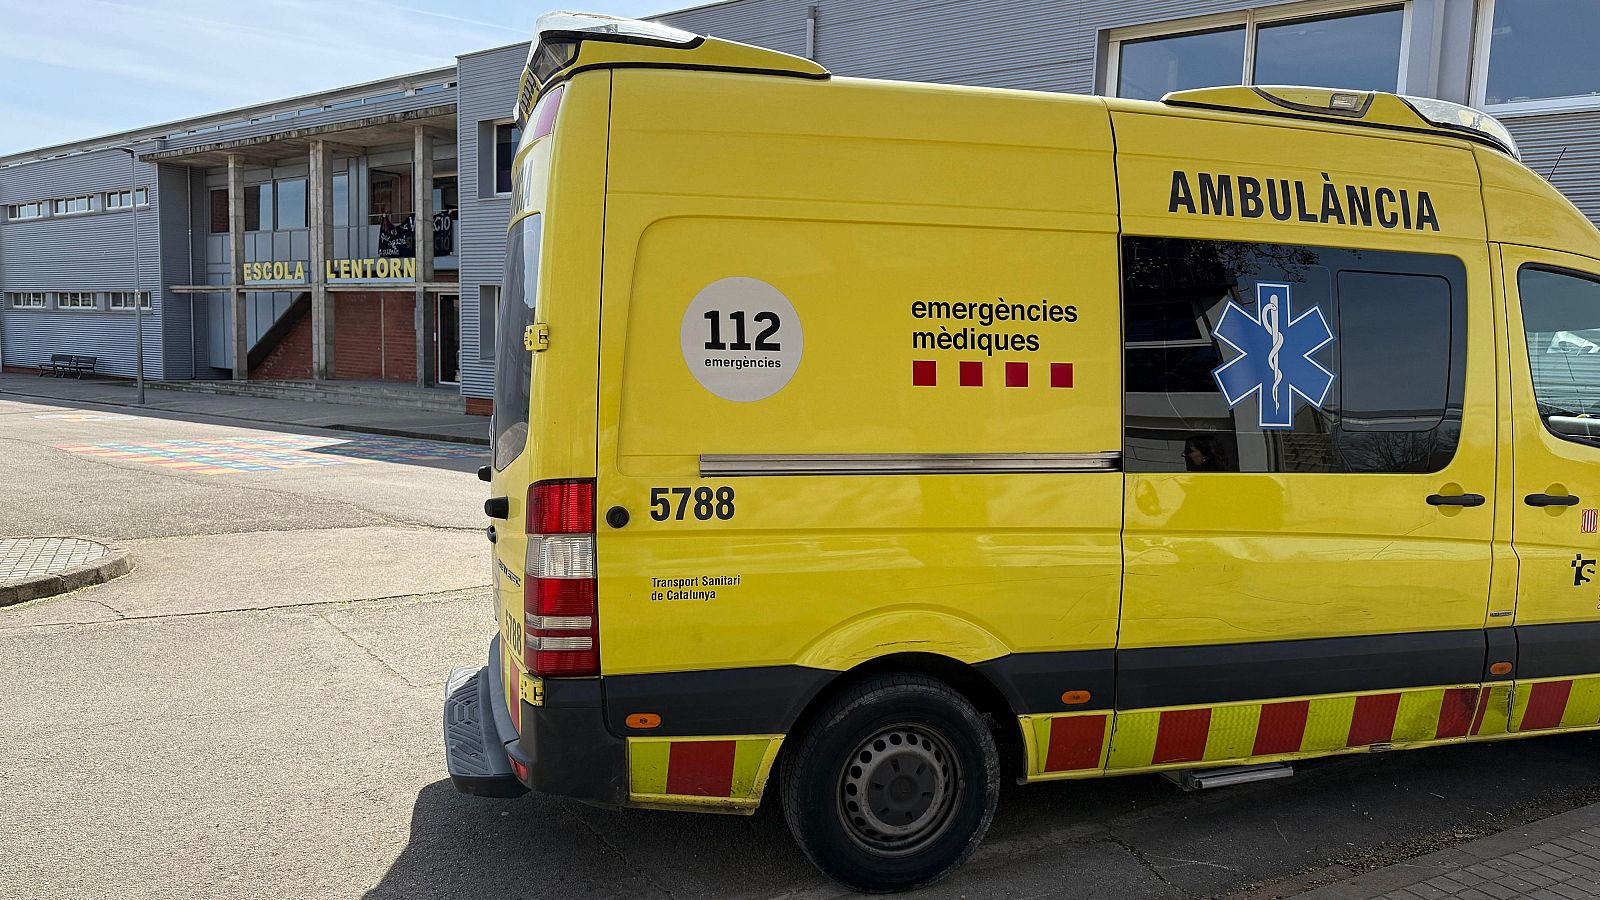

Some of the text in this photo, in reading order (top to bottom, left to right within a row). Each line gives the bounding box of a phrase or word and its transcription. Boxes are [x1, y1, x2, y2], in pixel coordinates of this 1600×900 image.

[1169, 171, 1440, 232] AMBULÀNCIA
[243, 257, 416, 281] ESCOLA L'ENTORN
[911, 297, 1078, 326] emergències
[703, 310, 781, 352] 112
[912, 327, 1040, 356] mèdiques
[704, 355, 782, 370] emergències
[650, 486, 735, 522] 5788
[651, 575, 741, 589] Transport Sanitari
[651, 589, 716, 602] de Catalunya
